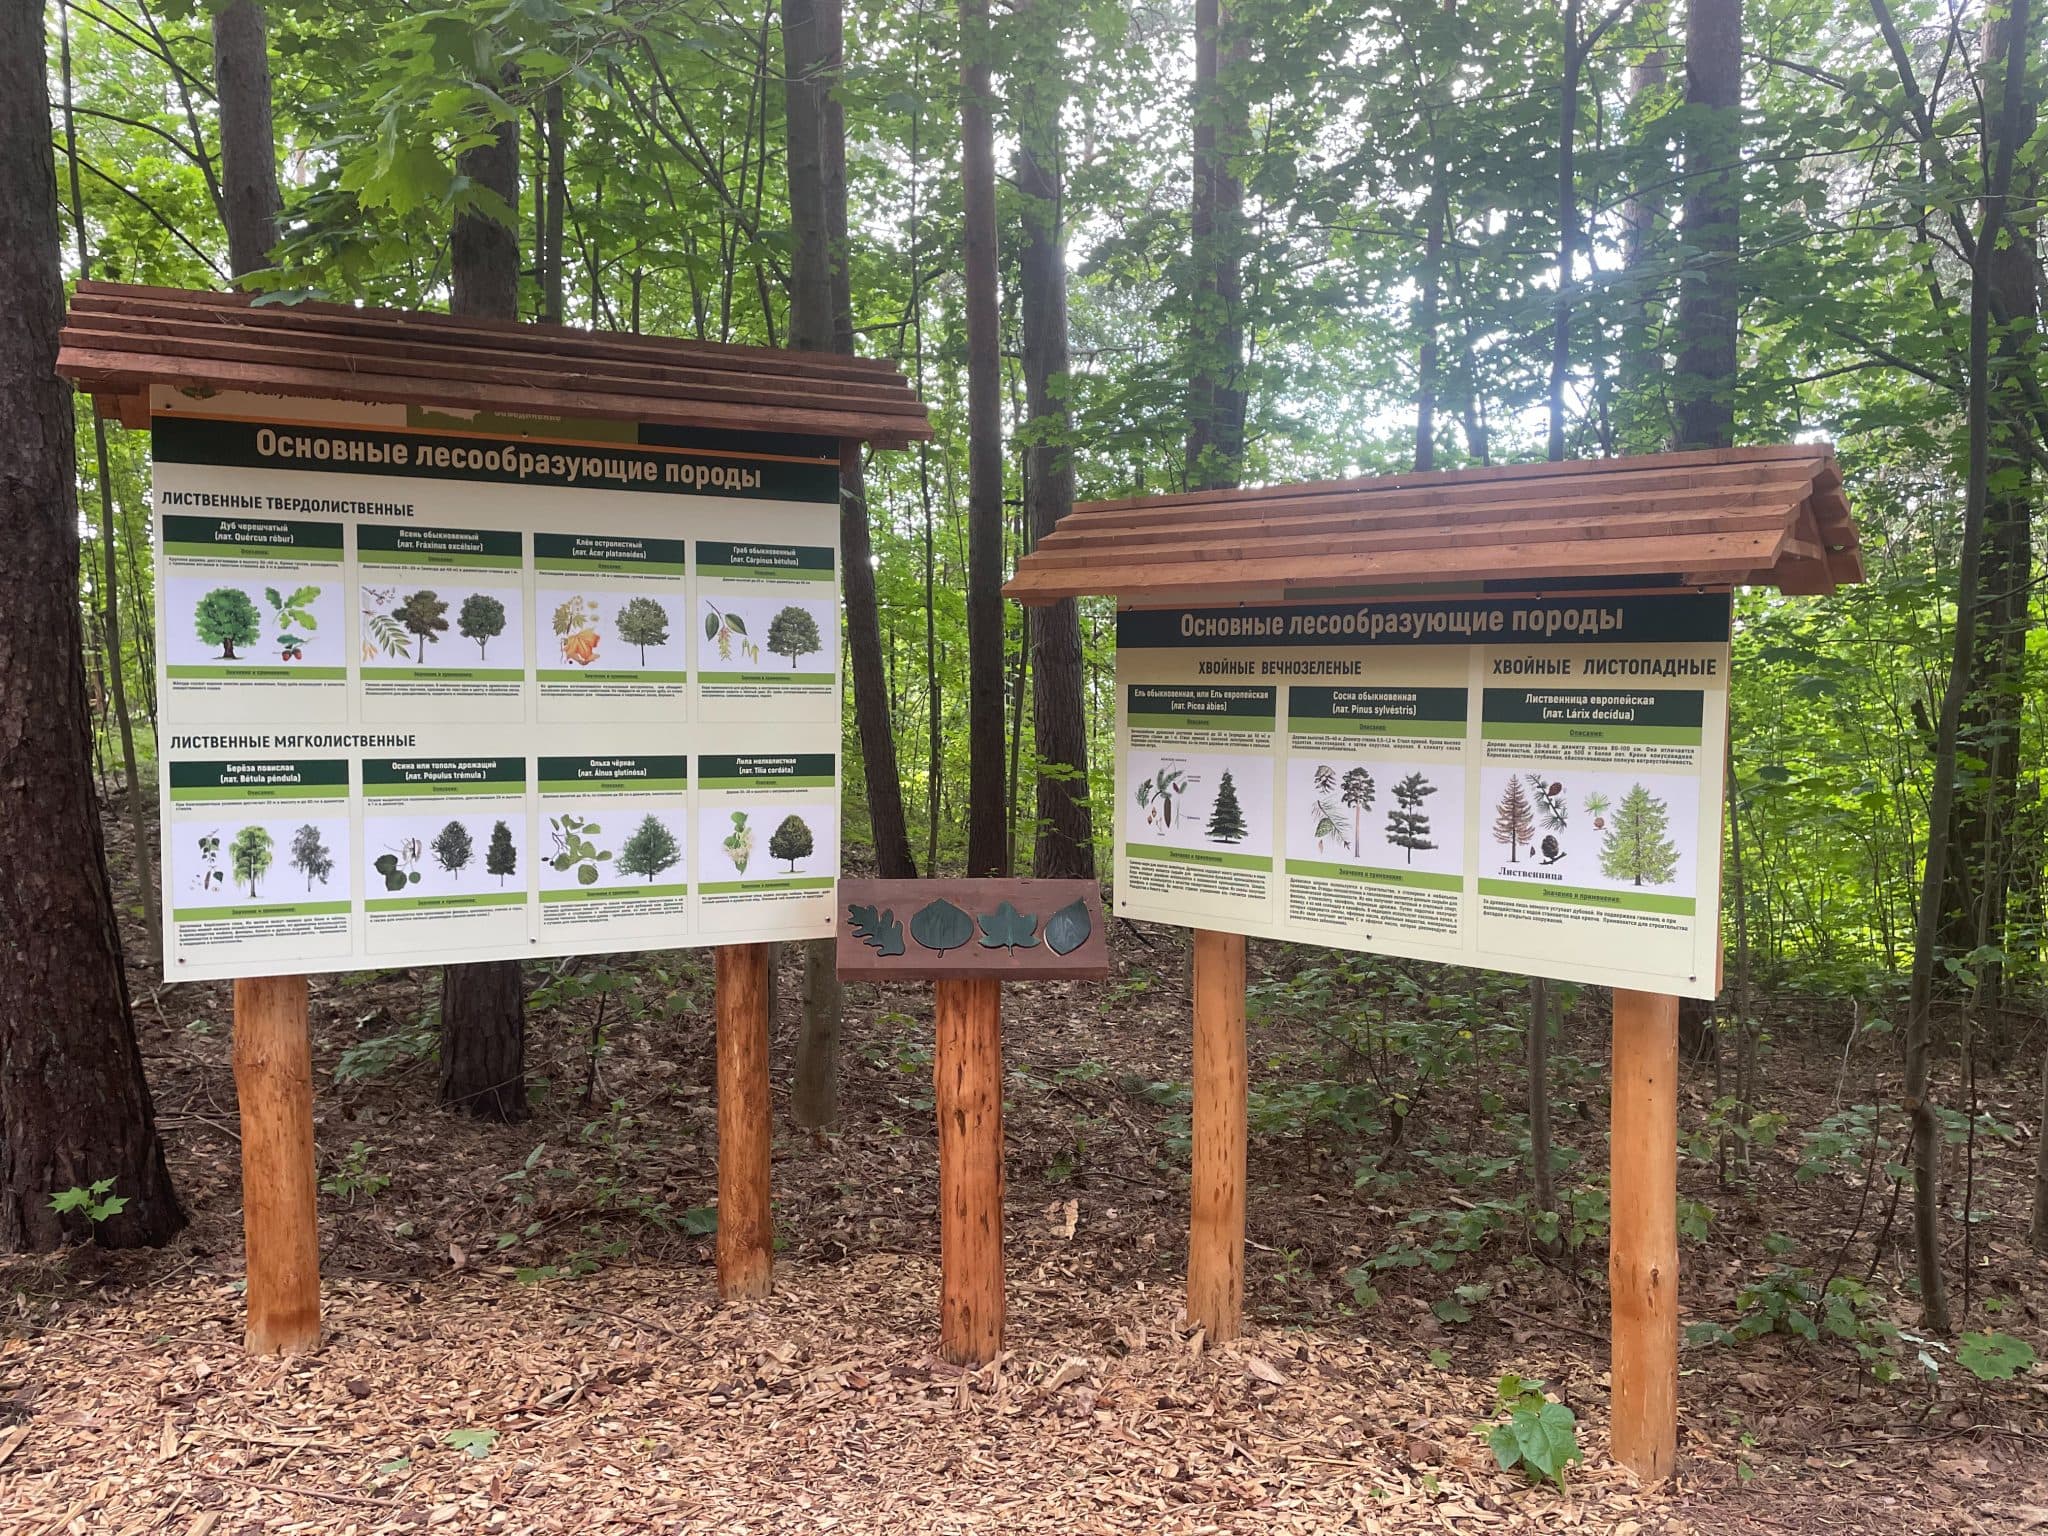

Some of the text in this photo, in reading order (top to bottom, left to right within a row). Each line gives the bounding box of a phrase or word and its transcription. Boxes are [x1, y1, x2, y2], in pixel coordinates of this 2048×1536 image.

[256, 428, 761, 490] Основные лесообразующие породы
[162, 491, 414, 517] ЛИСТВЕННЫЕ ТВЕРДОЛИСТВЕННЫЕ
[220, 521, 288, 533] Дуб черешчатый
[215, 531, 233, 541] (лат.
[400, 529, 422, 538] Ясень
[733, 546, 748, 554] Граб
[1181, 607, 1623, 639] Основные лесообразующие породы
[1199, 657, 1361, 675] ХВОЙНЫЕ ВЕЧНОЗЕЛЕНЫЕ
[1493, 655, 1716, 677] ХВОЙНЫЕ ЛИСТОПАДНЫЕ
[1135, 689, 1145, 697] Ель
[1210, 690, 1222, 698] Ель
[1333, 691, 1416, 702] Сосна обыкновенная
[1525, 693, 1655, 706] Лиственница европейская
[1332, 704, 1350, 715] (лат.
[1543, 707, 1564, 719] (лат.
[170, 734, 416, 749] ЛИСТВЕННЫЕ МЯГКОЛИСТВЕННЫЕ
[392, 762, 415, 770] Осина
[432, 762, 456, 770] тополь
[458, 760, 497, 771] дрожащий
[590, 759, 610, 767] Ольха
[227, 764, 294, 774] Берёза повислая
[220, 774, 238, 784] (лат.
[1498, 866, 1563, 881] Лиственница
